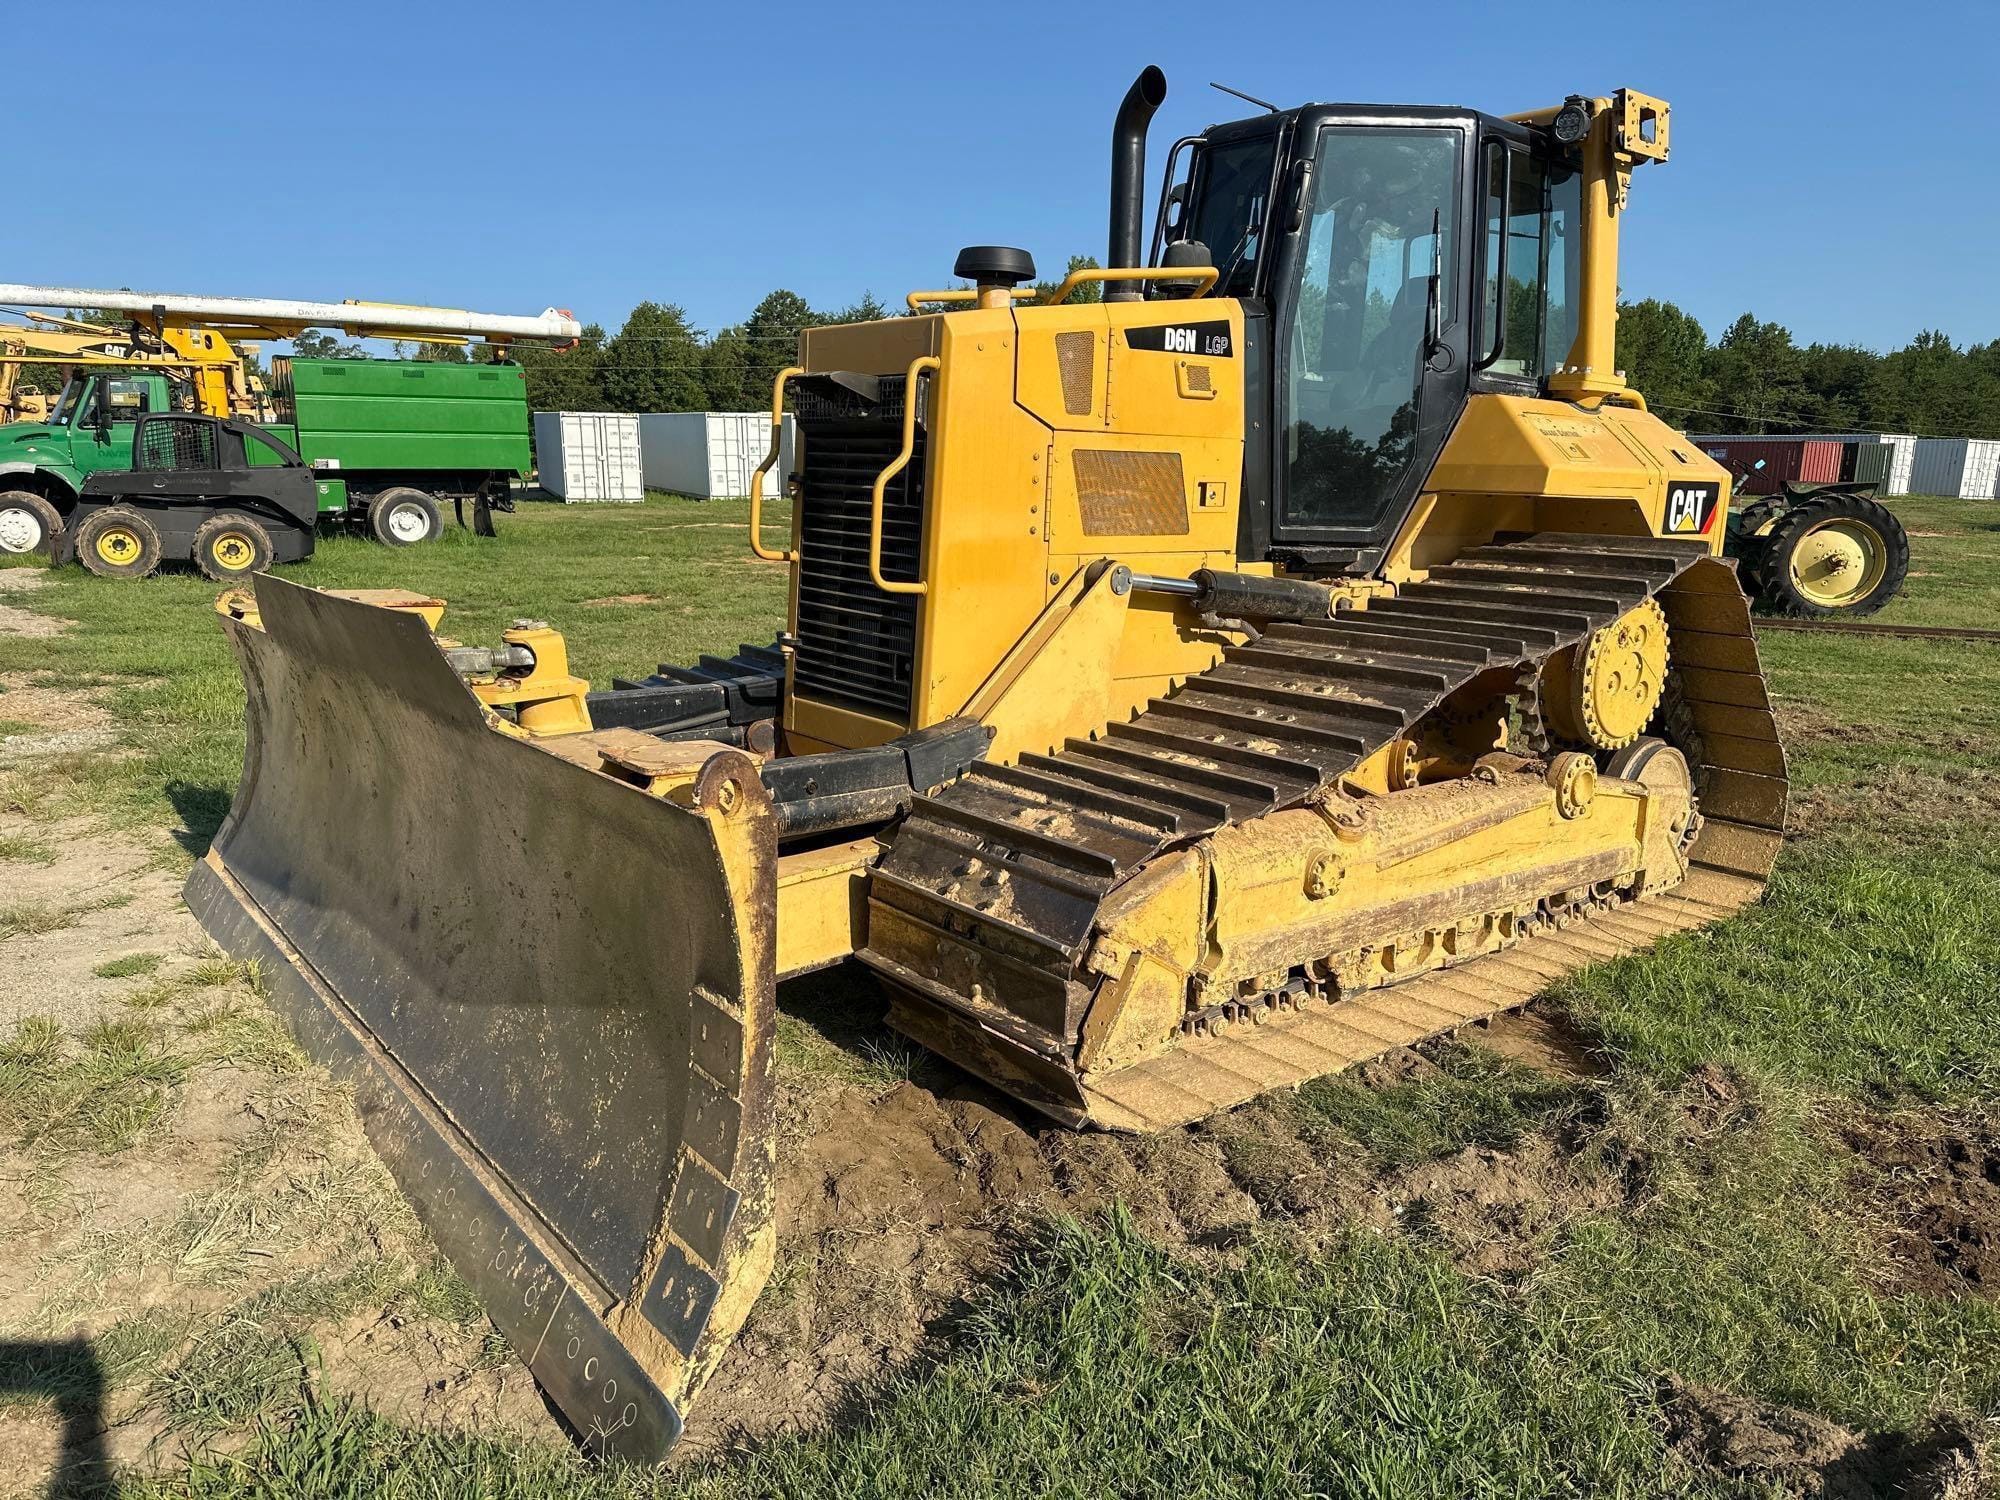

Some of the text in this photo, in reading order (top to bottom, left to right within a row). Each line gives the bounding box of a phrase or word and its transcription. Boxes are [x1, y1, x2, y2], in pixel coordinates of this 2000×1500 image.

[105, 343, 127, 358] CAT
[1164, 327, 1229, 355] D6N LGP
[1669, 489, 1707, 532] CAT
